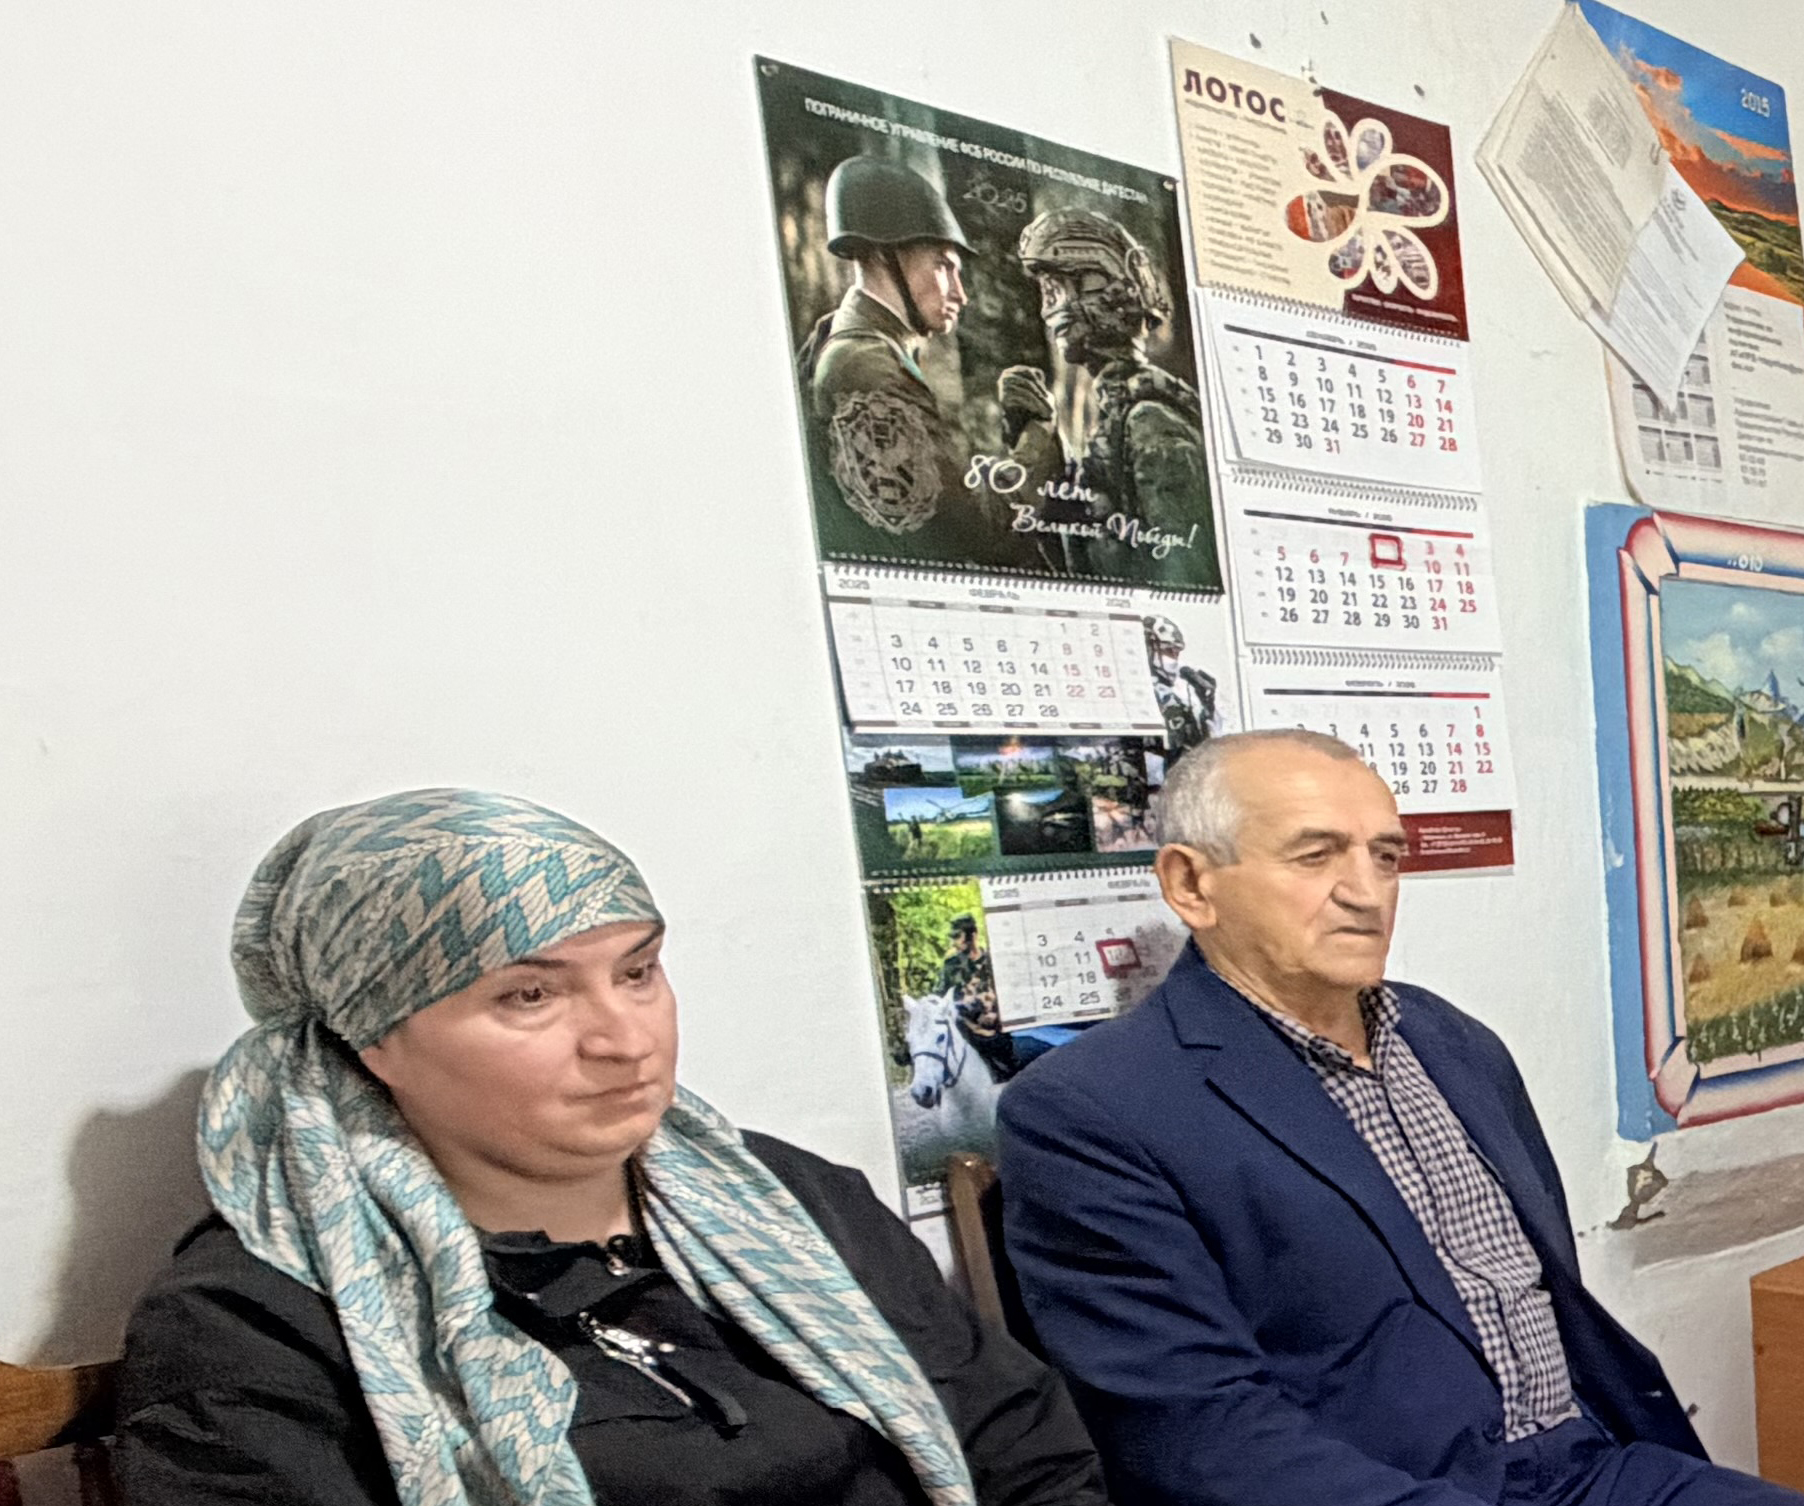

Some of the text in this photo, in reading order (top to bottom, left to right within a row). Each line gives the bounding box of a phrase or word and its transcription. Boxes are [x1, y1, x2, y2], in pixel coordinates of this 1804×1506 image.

[1183, 69, 1285, 123] ЛОТОС
[1255, 345, 1445, 393] 1 2 3 4 5 6 7
[1258, 366, 1453, 413] 8 9 10 11 12 13 14
[1258, 386, 1453, 432] 15 16 17 18 19 20 21
[1261, 406, 1457, 451] 22 23 24 25 26 27 28
[1265, 427, 1340, 454] 29 30 31
[964, 454, 1027, 494] 80
[1426, 541, 1465, 557] 3 4
[1277, 546, 1470, 576] 5 6 7 10 11
[1275, 566, 1474, 595] 12 13 14 15 16 17 18
[1278, 587, 1477, 613] 19 20 21 22 23 24 25
[1280, 607, 1447, 630] 26 27 28 29 30 31
[891, 634, 1039, 654] 3 4 5 7
[892, 657, 1049, 675] 10 11 12 13 14
[896, 680, 1051, 696] 17 18 19 20 21
[1474, 706, 1481, 719] 1
[1360, 723, 1484, 738] 4 5 6 7 8
[1359, 742, 1491, 757] 11 12 13 14 15
[1391, 760, 1493, 775] 19 20 21 22
[1393, 779, 1467, 795] 26 27 28
[1037, 931, 1084, 947] 3 4
[1037, 951, 1091, 967] 10 11
[1040, 971, 1096, 988] 17 18
[1042, 991, 1100, 1009] 24 25
